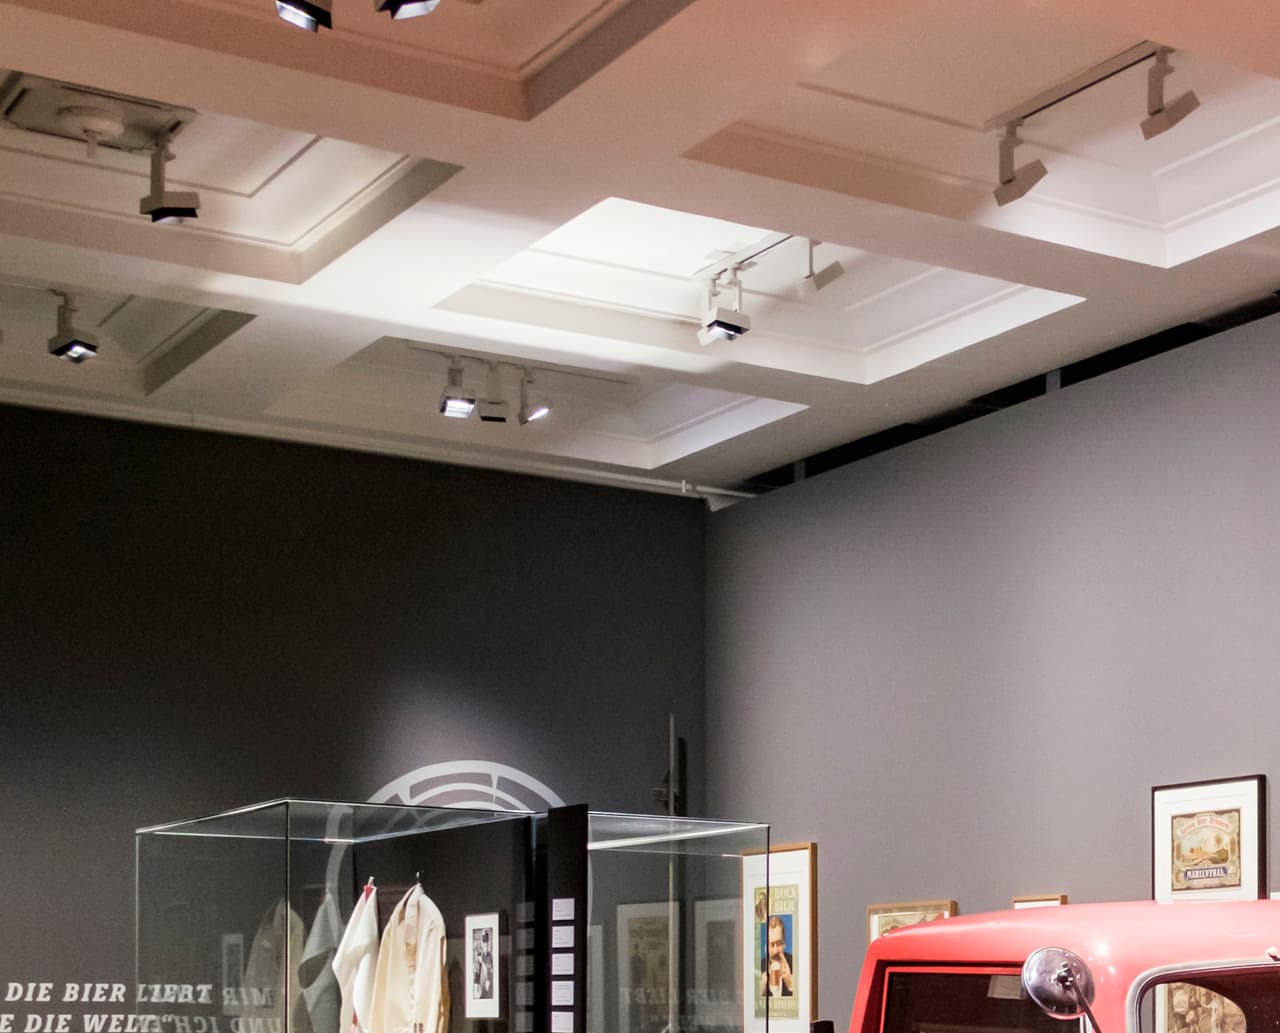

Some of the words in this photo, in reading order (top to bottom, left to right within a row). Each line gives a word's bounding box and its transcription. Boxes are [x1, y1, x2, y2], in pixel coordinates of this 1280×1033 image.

[5, 982, 53, 1002] DIE
[62, 982, 127, 1002] BIER
[24, 1014, 72, 1033] DIE
